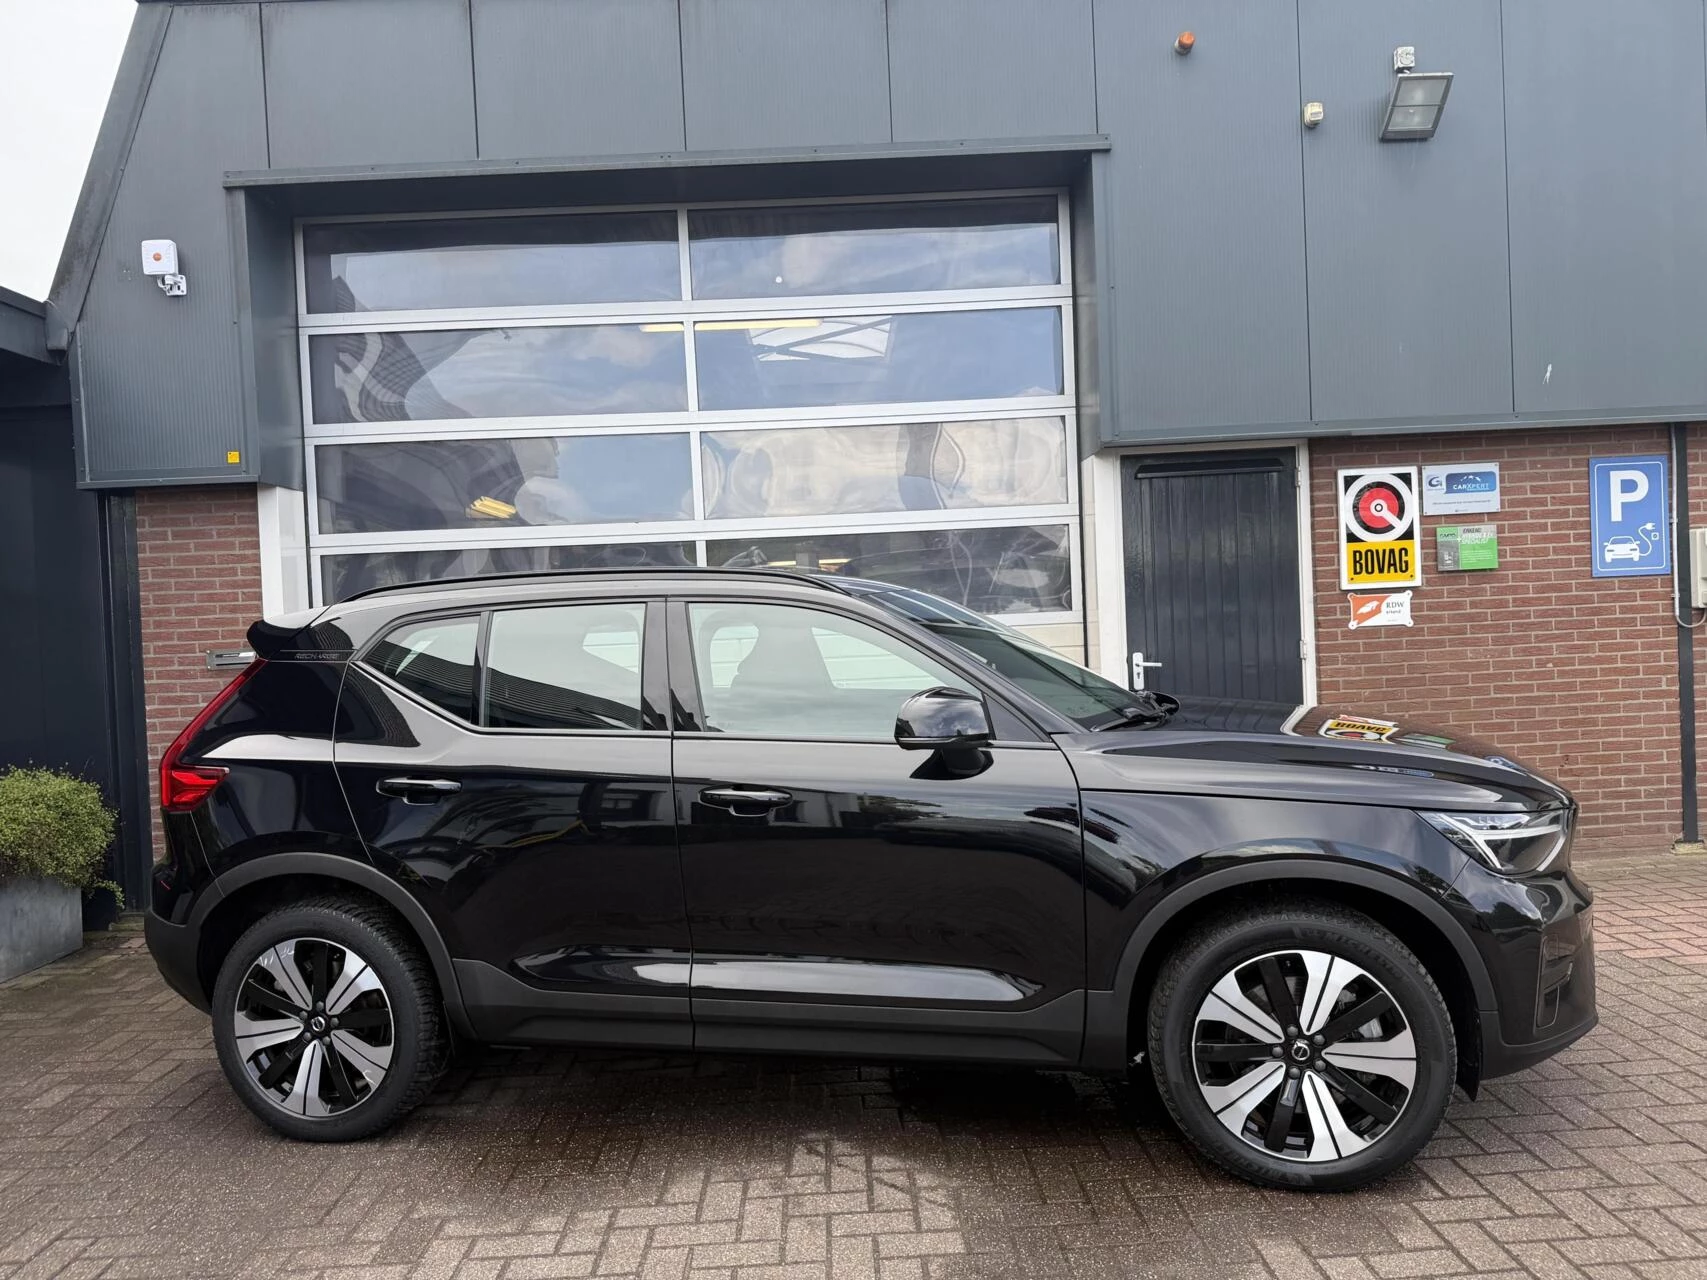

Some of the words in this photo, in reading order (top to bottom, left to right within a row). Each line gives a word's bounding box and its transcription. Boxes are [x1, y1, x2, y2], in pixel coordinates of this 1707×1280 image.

[1453, 483, 1489, 491] CARXPERT
[1610, 471, 1650, 522] P
[1353, 547, 1409, 575] BOVAG
